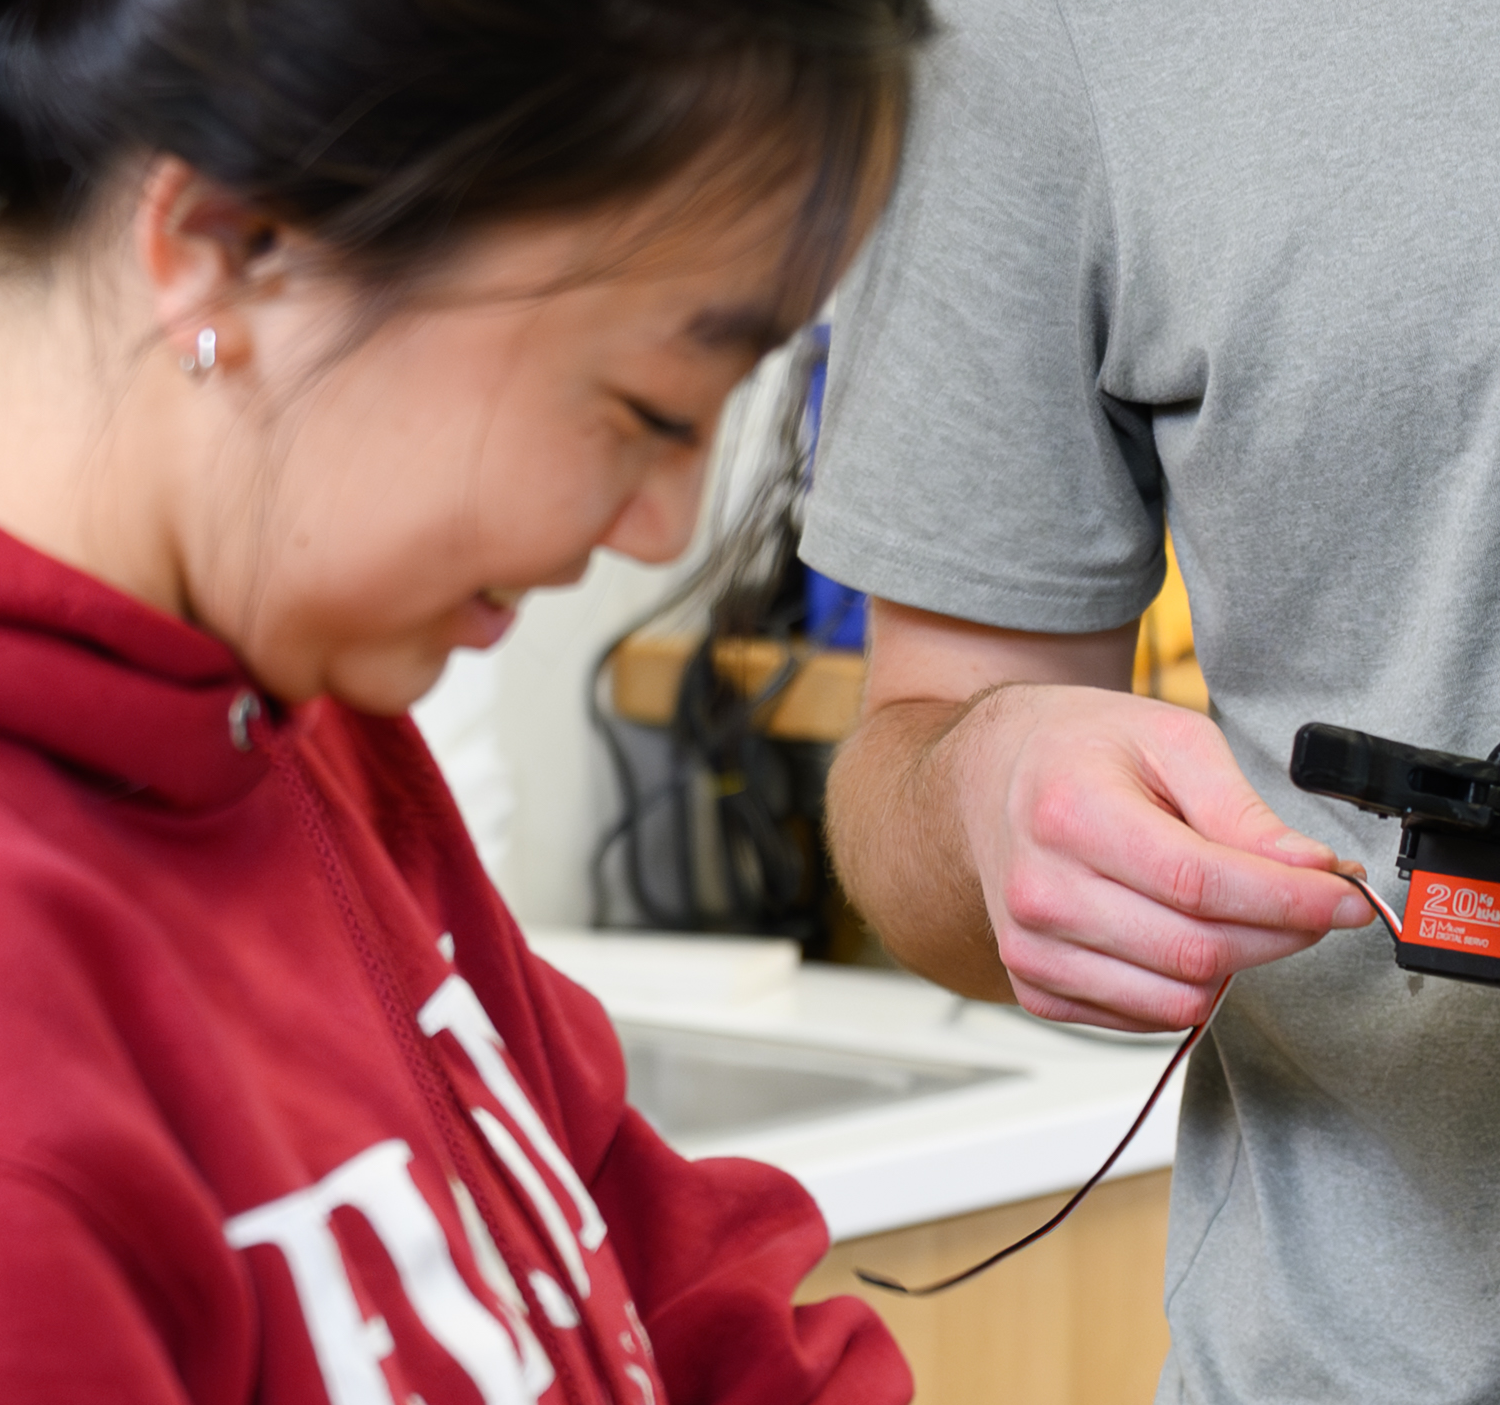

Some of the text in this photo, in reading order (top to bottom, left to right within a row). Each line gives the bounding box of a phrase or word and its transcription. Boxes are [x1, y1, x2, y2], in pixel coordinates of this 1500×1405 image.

[1423, 883, 1478, 918] 20
[1478, 893, 1495, 907] Kg
[1436, 933, 1490, 949] DIGITAL SERVO
